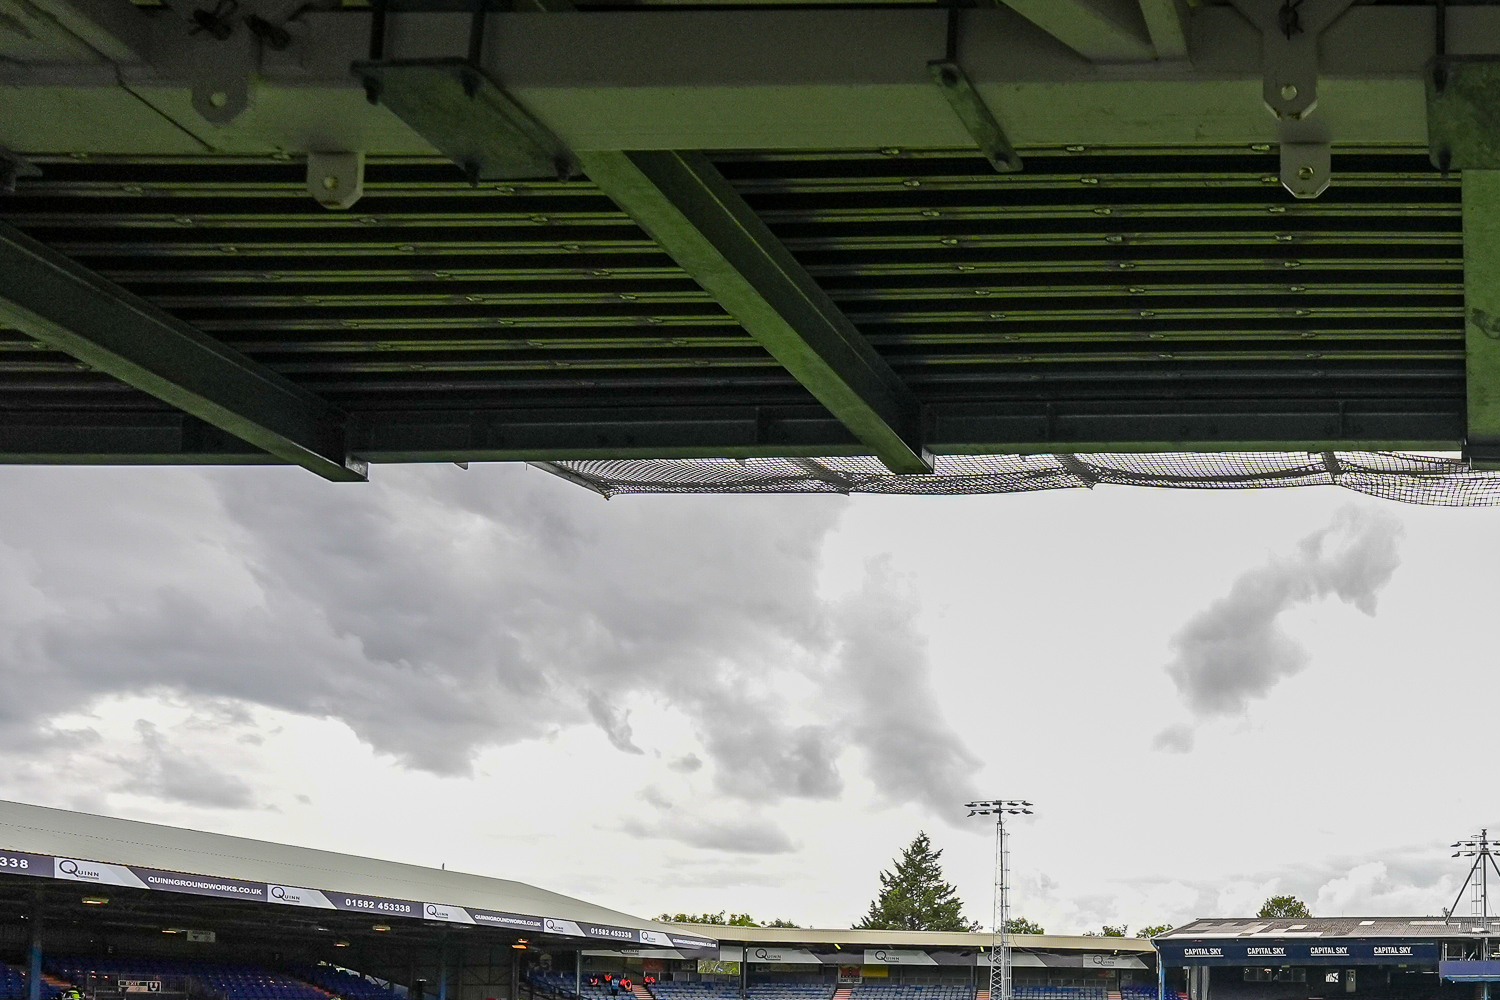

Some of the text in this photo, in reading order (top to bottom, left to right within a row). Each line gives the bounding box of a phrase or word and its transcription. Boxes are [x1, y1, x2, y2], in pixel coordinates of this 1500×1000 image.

[59, 859, 100, 878] QUINN
[148, 876, 262, 895] QUINNGROUNDWORKS.CO.UK
[345, 898, 411, 913] 01582 453338
[1247, 947, 1285, 955] CAPITAL SKY
[1373, 946, 1412, 954] CAPITAL SKY
